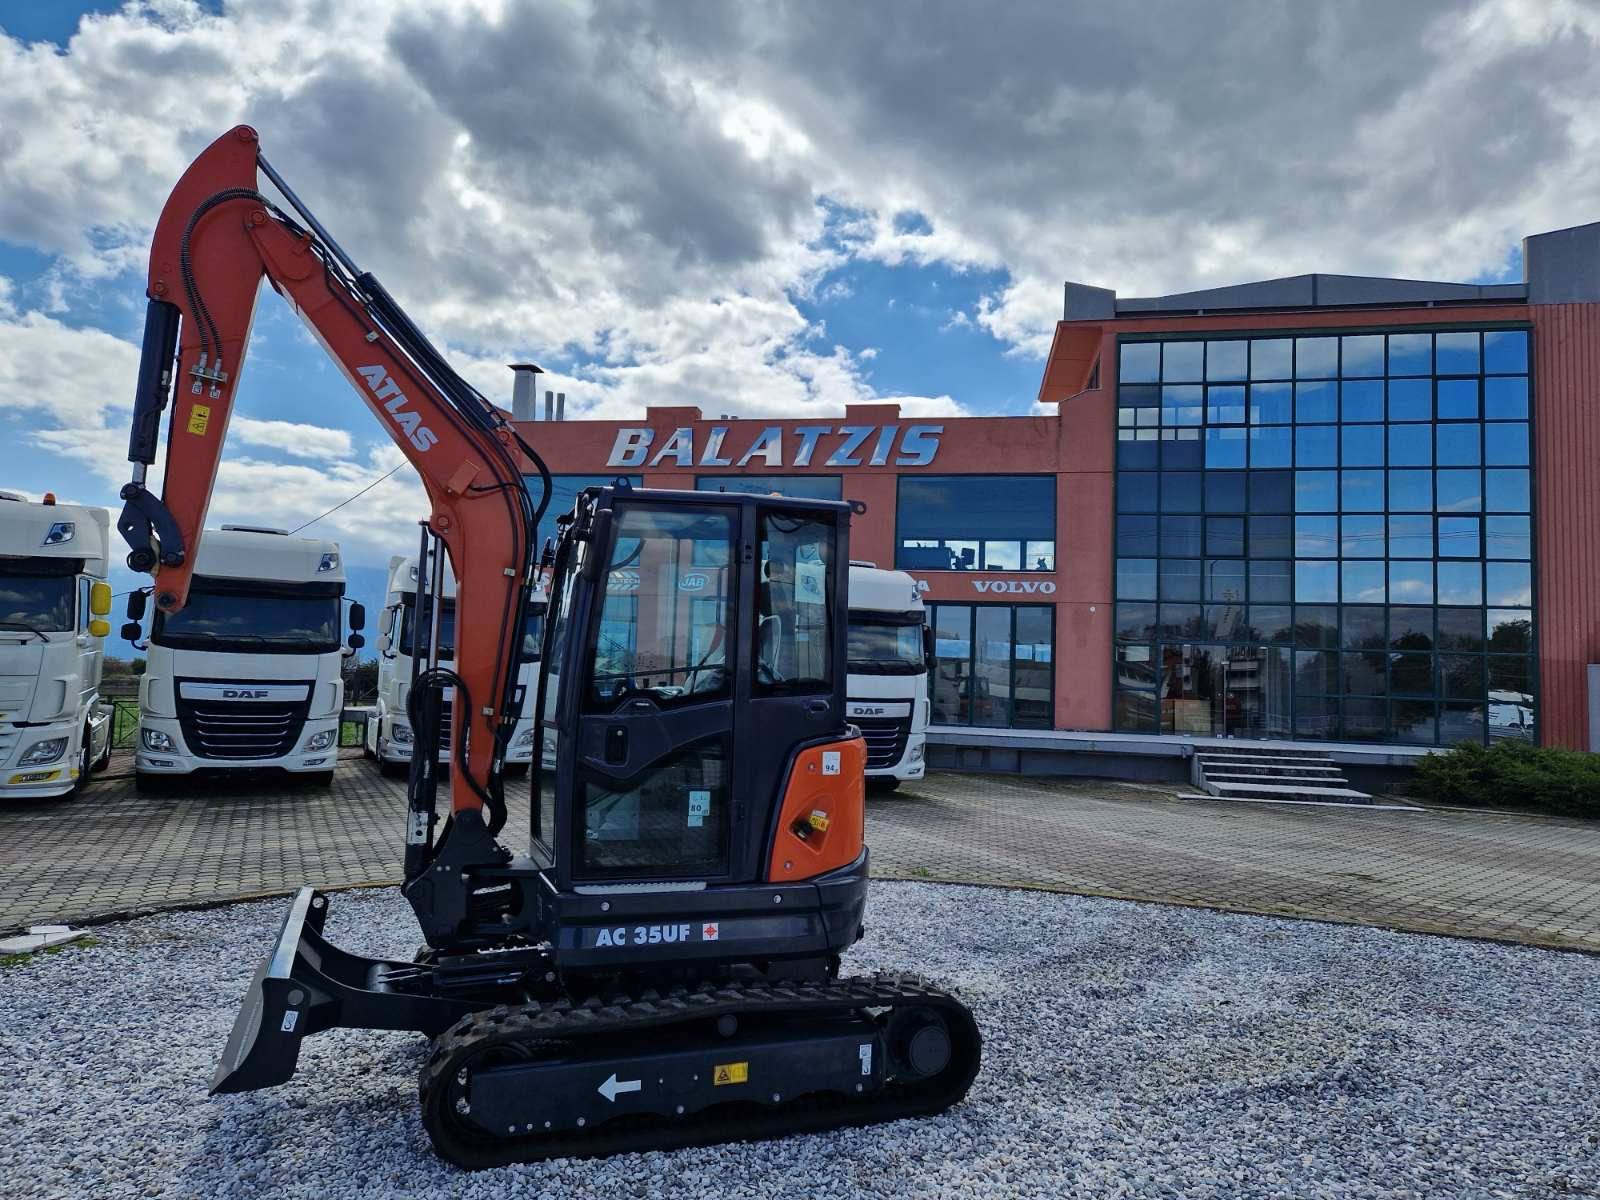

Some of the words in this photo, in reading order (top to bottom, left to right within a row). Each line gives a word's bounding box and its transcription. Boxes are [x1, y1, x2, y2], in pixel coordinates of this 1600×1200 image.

[356, 365, 439, 452] ATLAS
[606, 426, 945, 468] BALATZIS
[973, 580, 1056, 593] VOLVO
[223, 690, 268, 699] DAF
[854, 707, 884, 715] DAF
[596, 927, 626, 947] AC
[634, 924, 690, 944] 35UF
